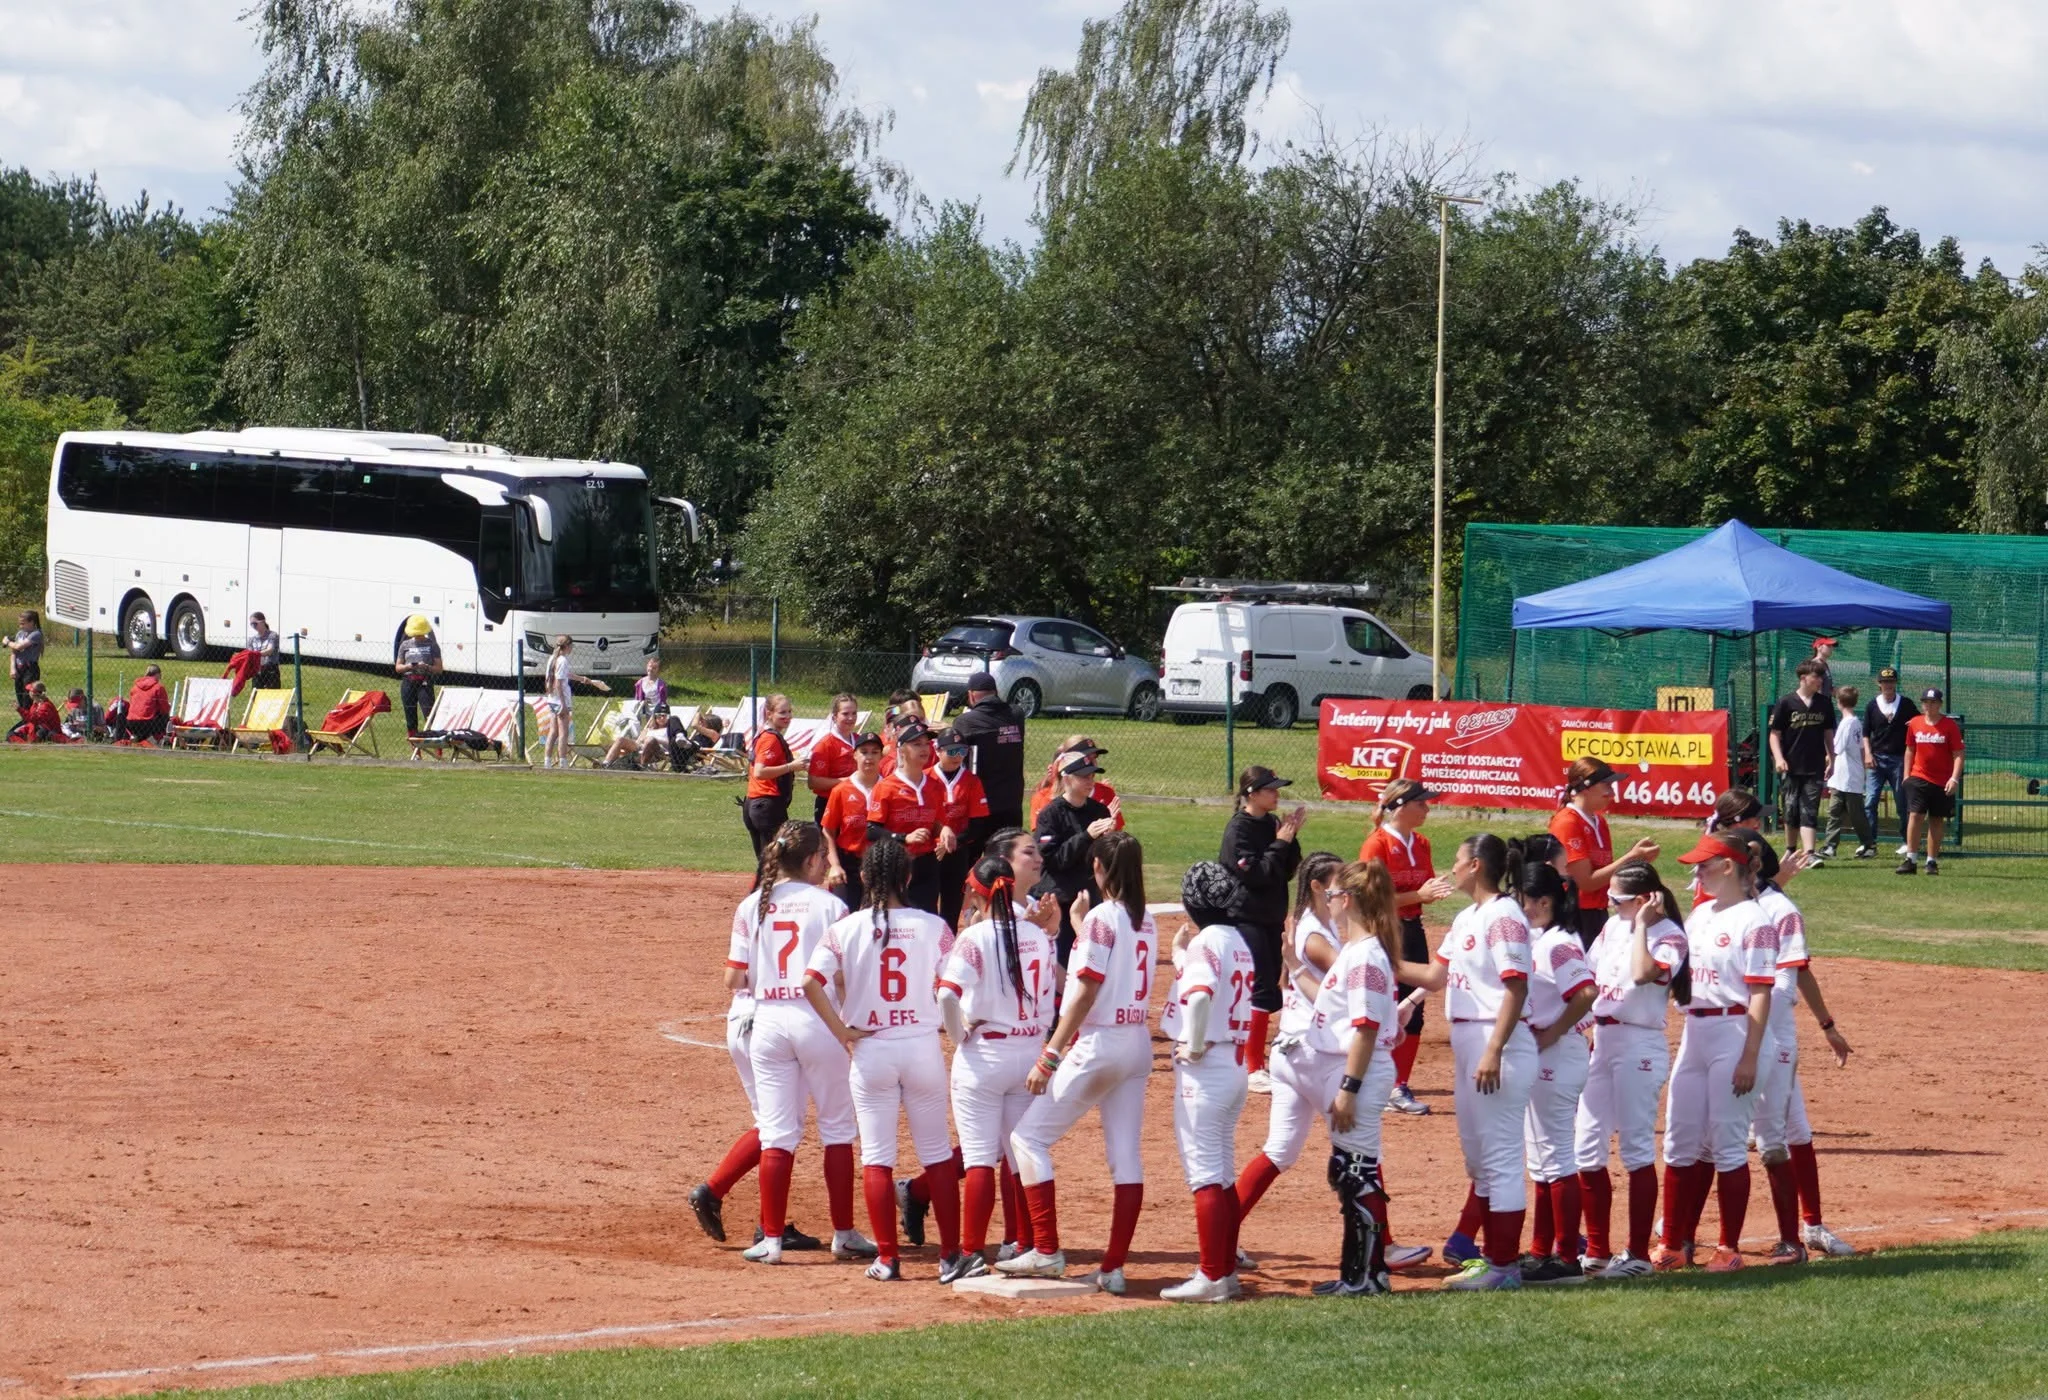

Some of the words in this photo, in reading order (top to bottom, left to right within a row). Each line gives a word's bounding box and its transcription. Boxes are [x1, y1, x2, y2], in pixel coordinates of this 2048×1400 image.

[586, 480, 596, 489] EZ
[597, 480, 605, 489] 13
[1329, 703, 1384, 733] Jesteśmy
[1387, 710, 1428, 734] szybcy
[1426, 711, 1452, 735] jak
[1561, 719, 1588, 728] ZAMÓW
[1588, 721, 1613, 730] ONLINE
[1350, 747, 1399, 768] KFC
[1566, 737, 1707, 759] KFCDOSTAWA.PL
[1421, 754, 1440, 765] KFC
[1440, 752, 1466, 765] ŻORY
[1467, 755, 1523, 768] DOSTARCZY
[1356, 769, 1389, 778] DOSTAWA
[1421, 766, 1468, 779] ŚWIEŻEGO
[1469, 770, 1520, 782] KURCZAKA
[1422, 782, 1460, 793] PROSTO
[1459, 784, 1473, 794] DO
[1474, 785, 1521, 796] TWOJEGO
[1521, 787, 1557, 799] DOMU!
[1623, 781, 1652, 804] 46
[1655, 781, 1684, 805] 46
[1686, 782, 1717, 805] 46
[773, 921, 800, 979] 7
[880, 948, 907, 1002] 6
[1135, 940, 1149, 1001] 3
[868, 1010, 883, 1026] A.
[889, 1009, 919, 1026] EFE
